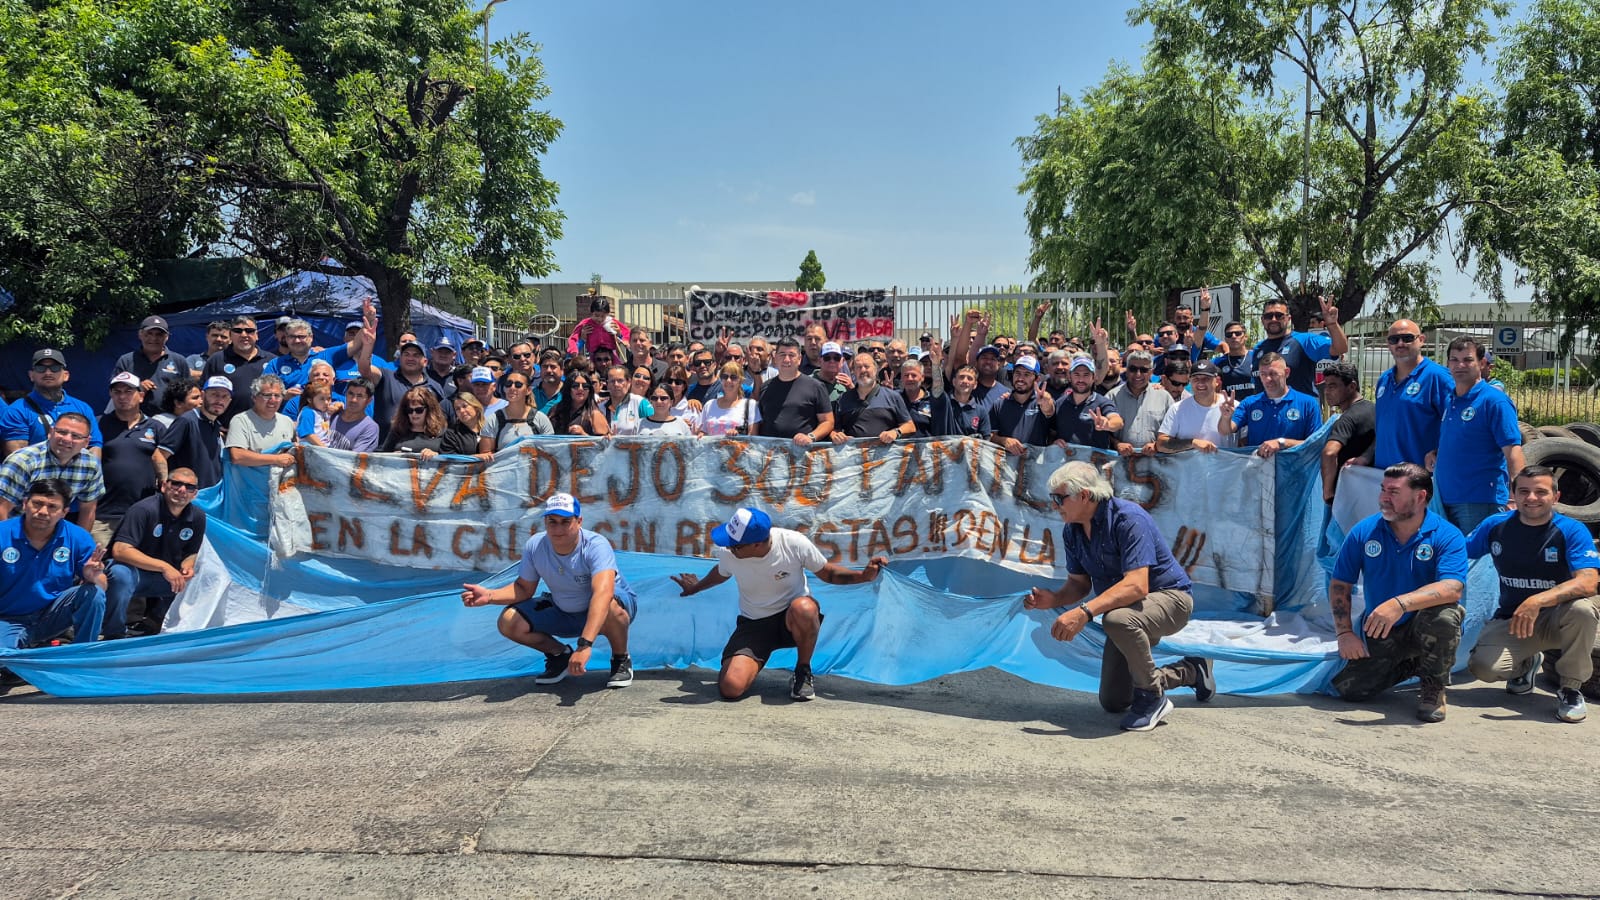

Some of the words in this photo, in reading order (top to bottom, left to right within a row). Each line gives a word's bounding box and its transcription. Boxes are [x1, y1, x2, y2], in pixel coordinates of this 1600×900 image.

[520, 441, 687, 511] DEJO
[711, 439, 834, 512] 300
[309, 511, 364, 551] EN
[390, 523, 432, 560] LA
